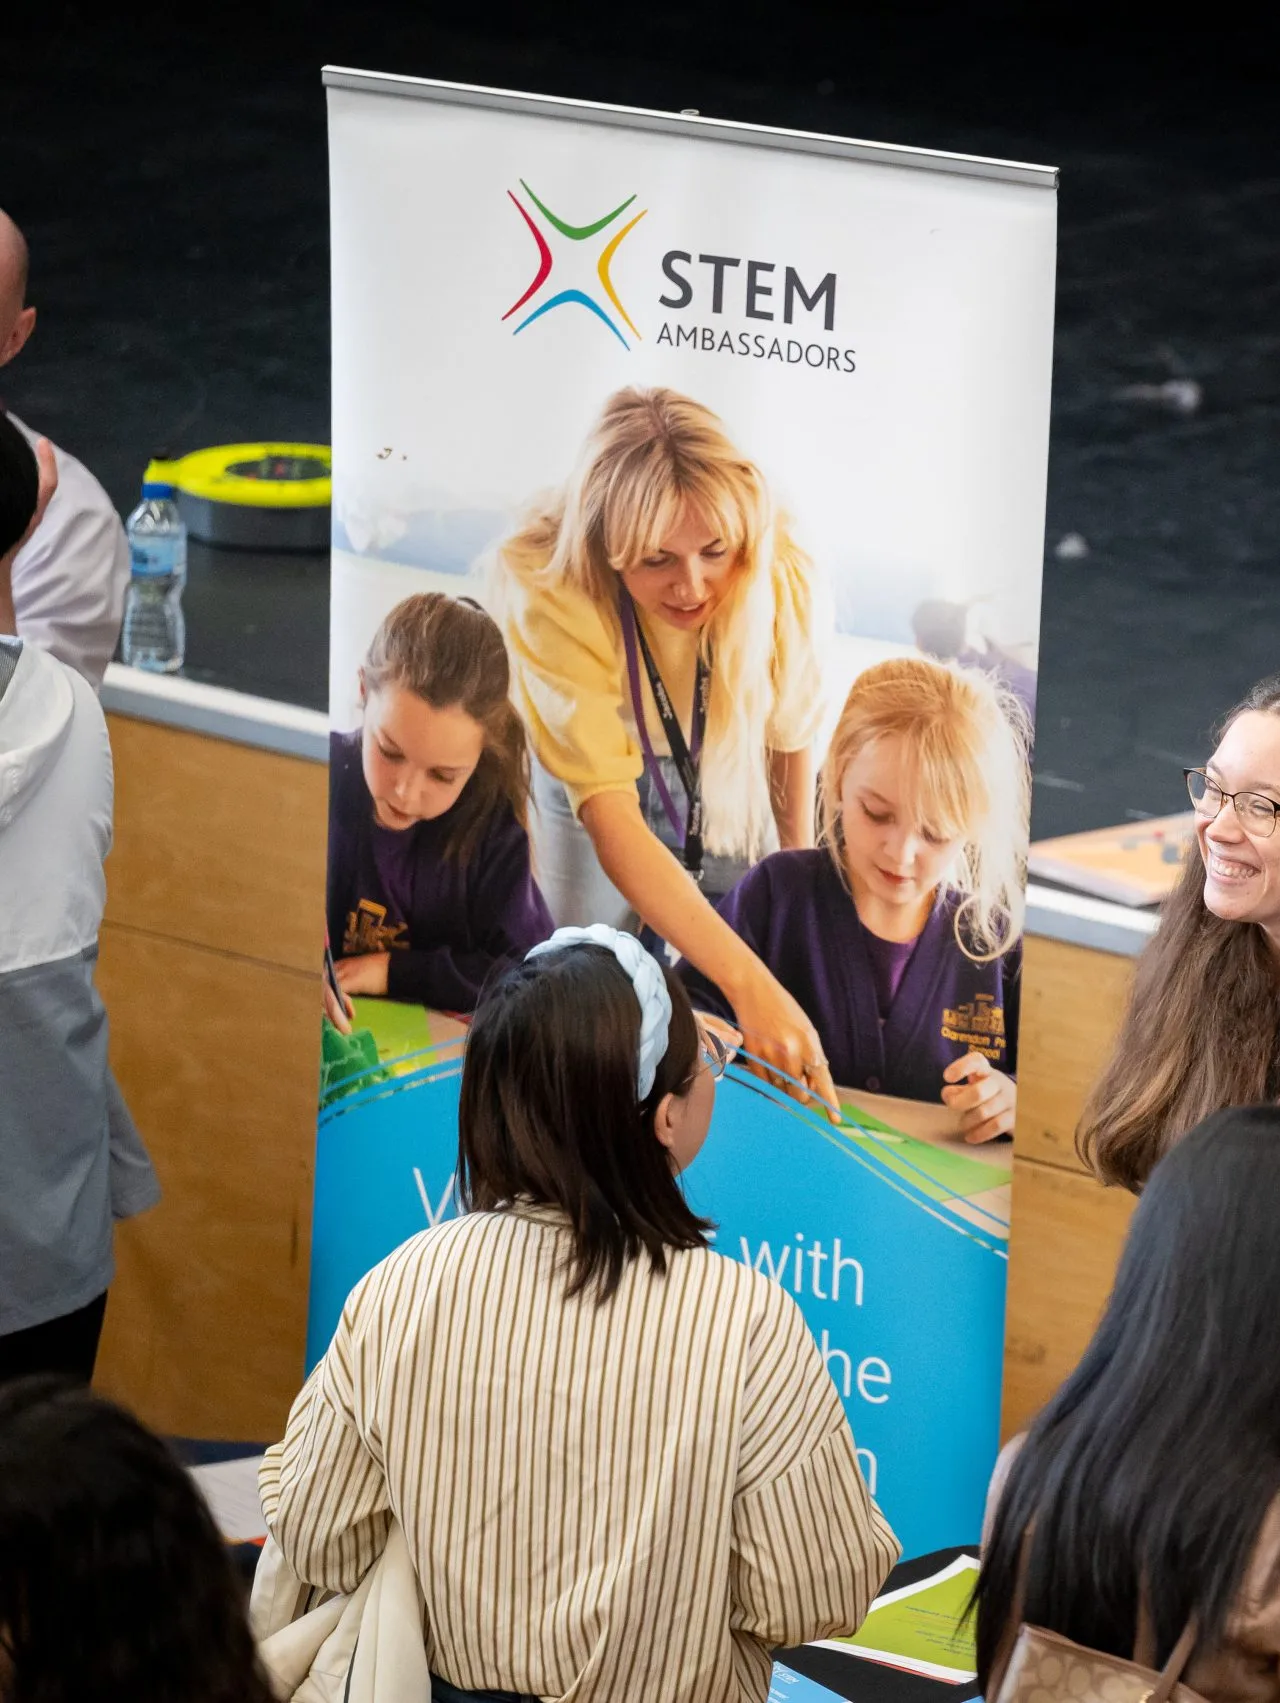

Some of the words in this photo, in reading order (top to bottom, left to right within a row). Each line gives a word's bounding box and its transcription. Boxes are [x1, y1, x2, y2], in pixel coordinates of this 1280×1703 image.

[658, 250, 838, 331] STEM
[656, 322, 857, 373] AMBASSADORS
[739, 1232, 864, 1307] with
[821, 1328, 892, 1404] he
